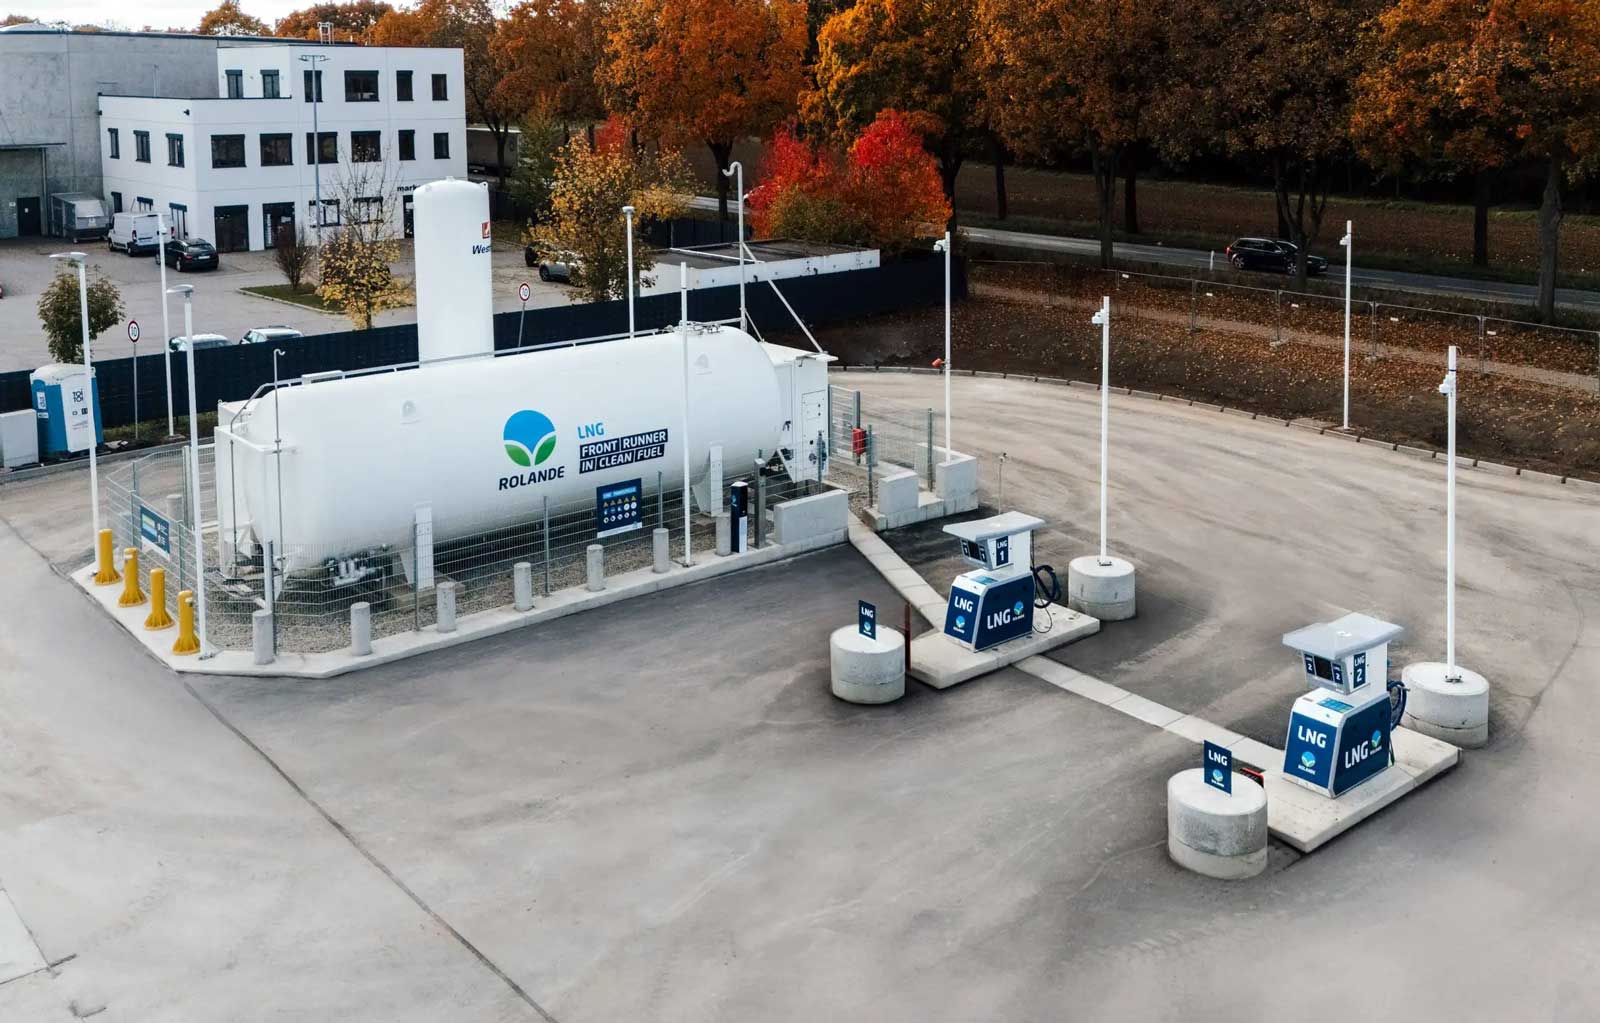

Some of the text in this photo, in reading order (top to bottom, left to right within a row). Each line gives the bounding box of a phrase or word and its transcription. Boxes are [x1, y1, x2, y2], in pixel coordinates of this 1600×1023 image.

[472, 244, 491, 255] Wes
[131, 326, 138, 337] 10
[577, 422, 605, 439] LNG
[581, 431, 667, 457] FRONT RUNNER
[581, 446, 664, 472] IN CLEAN FUEL
[498, 466, 565, 490] ROLANDE
[997, 540, 1007, 549] LNG
[1000, 550, 1004, 561] 1
[954, 596, 974, 613] LNG
[861, 606, 874, 619] LNG
[987, 608, 1011, 630] LNG
[1308, 663, 1313, 672] 2
[1354, 655, 1365, 667] LNG
[1335, 672, 1341, 680] 2
[1356, 668, 1363, 682] 2
[1297, 725, 1327, 749] LNG
[1208, 749, 1228, 767] LNG
[1345, 740, 1369, 769] LNG
